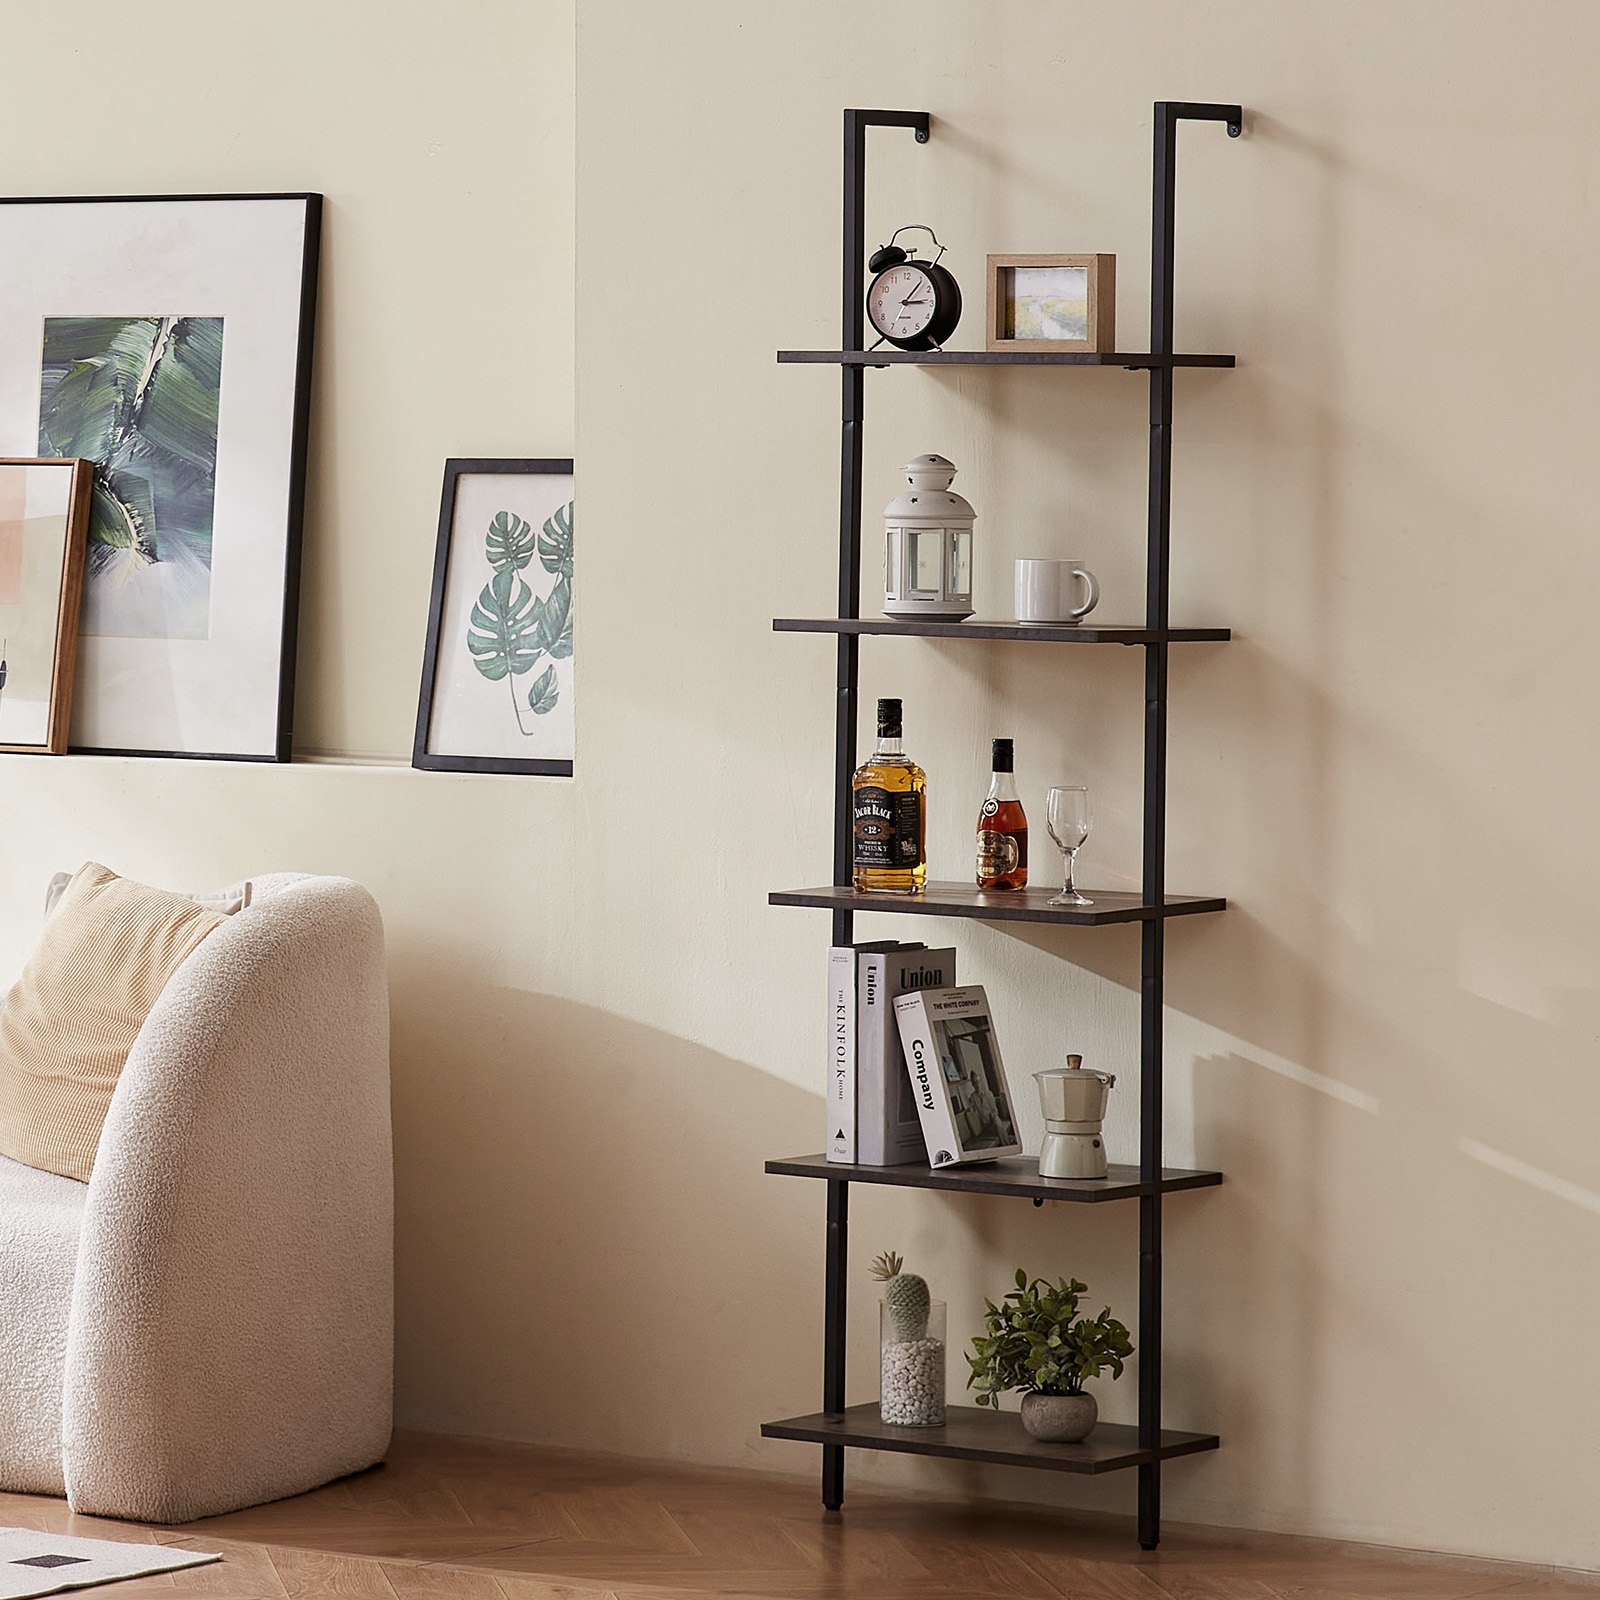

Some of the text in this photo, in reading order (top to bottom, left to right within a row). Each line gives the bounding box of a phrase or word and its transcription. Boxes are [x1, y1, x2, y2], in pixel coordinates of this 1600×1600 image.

[890, 276, 898, 284] 11
[903, 272, 912, 280] 12
[880, 285, 890, 294] 10
[872, 803, 893, 820] BLACK
[868, 825, 877, 834] 12
[858, 844, 889, 852] WHISKY
[900, 965, 943, 990] Union
[867, 965, 877, 1005] Union
[943, 1001, 958, 1009] WHITE
[958, 1000, 980, 1008] COMPANY
[836, 1004, 846, 1078] KINFOLK
[912, 1039, 935, 1111] Company
